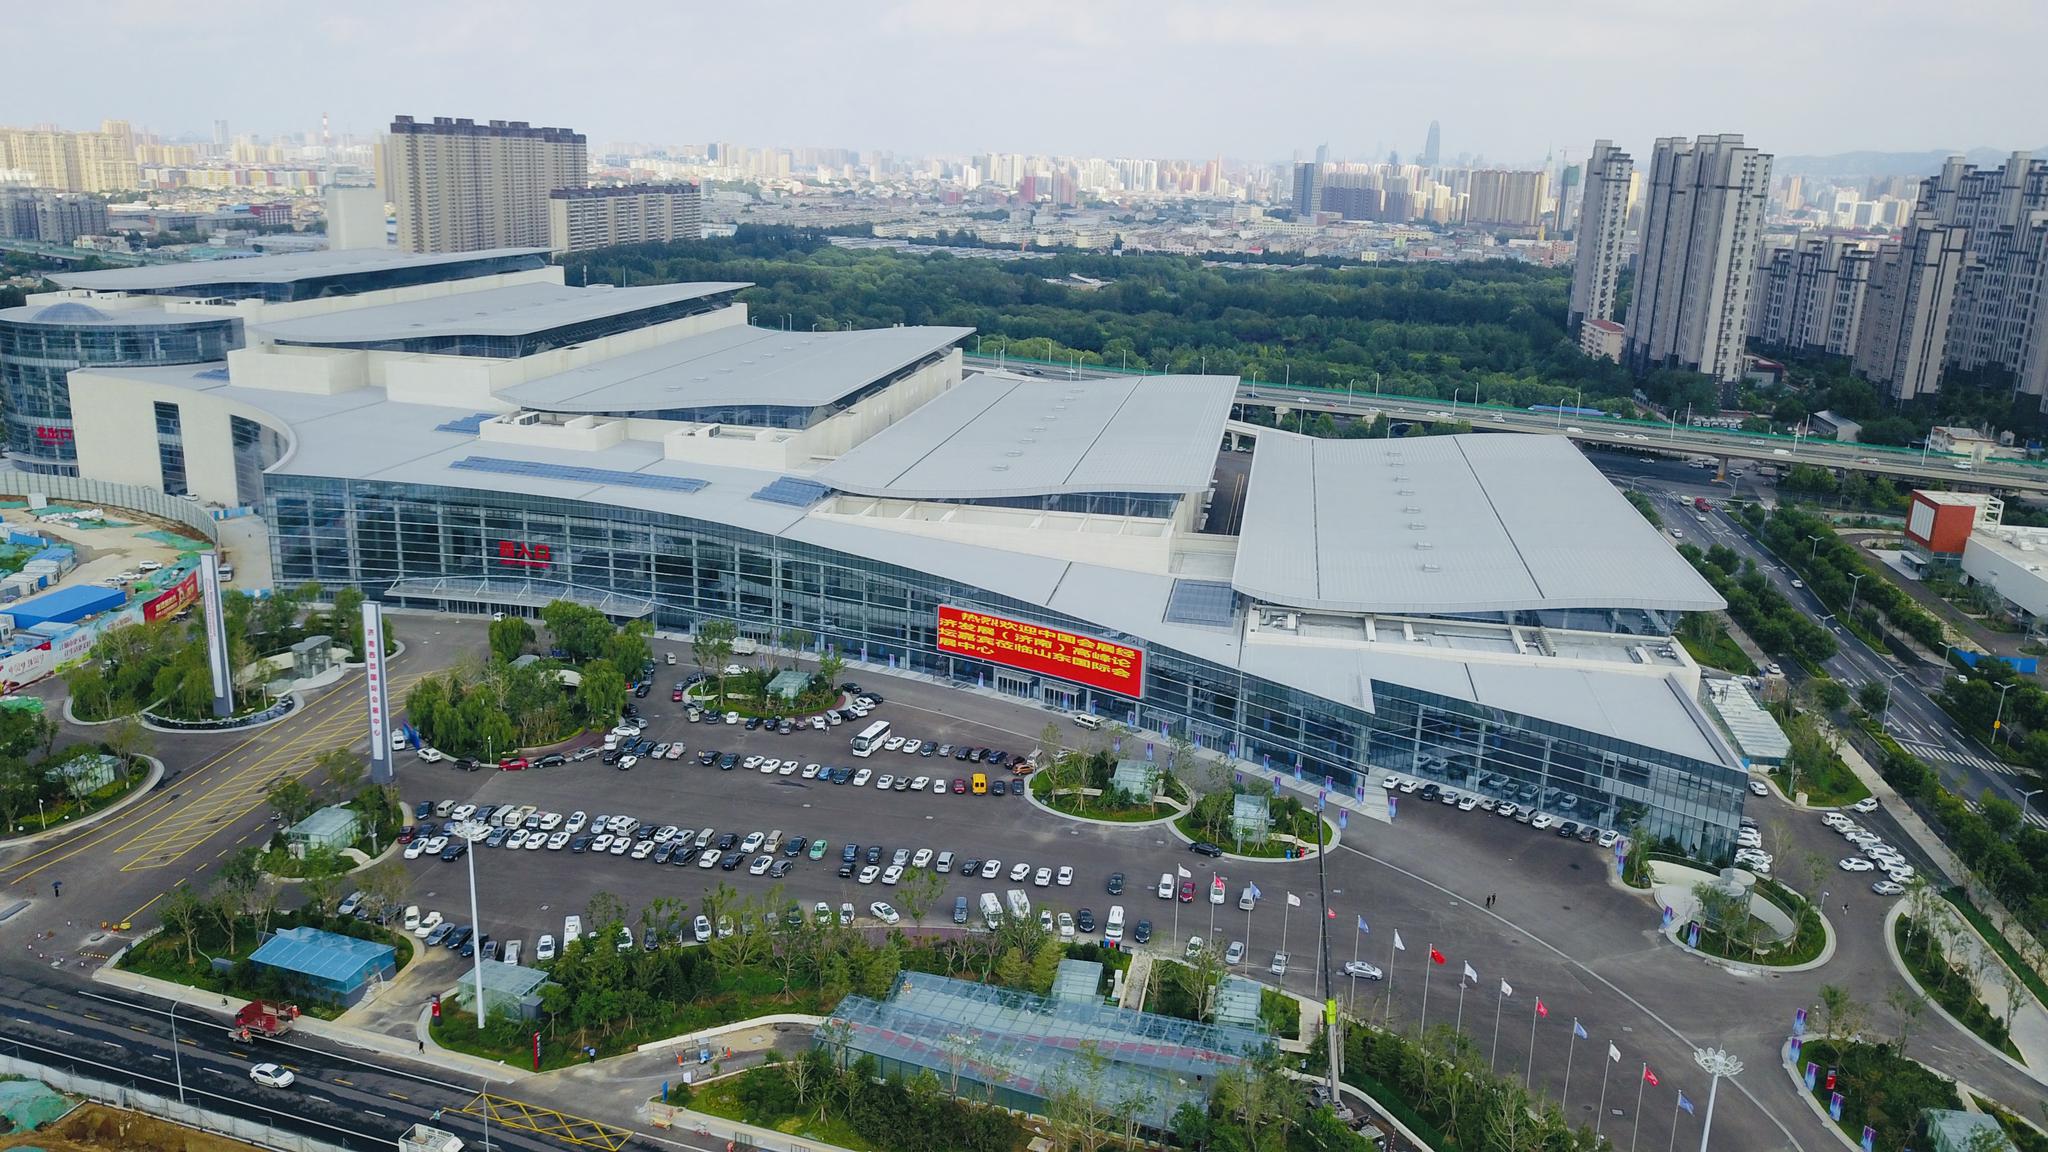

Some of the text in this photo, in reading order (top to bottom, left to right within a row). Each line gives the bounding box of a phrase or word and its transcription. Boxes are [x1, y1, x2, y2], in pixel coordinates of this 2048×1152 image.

[939, 637, 994, 654] 展中心
[939, 628, 1130, 678] 坛嘉宾莅临山东国际会
[961, 613, 1135, 659] 热烈欢迎中国会展经
